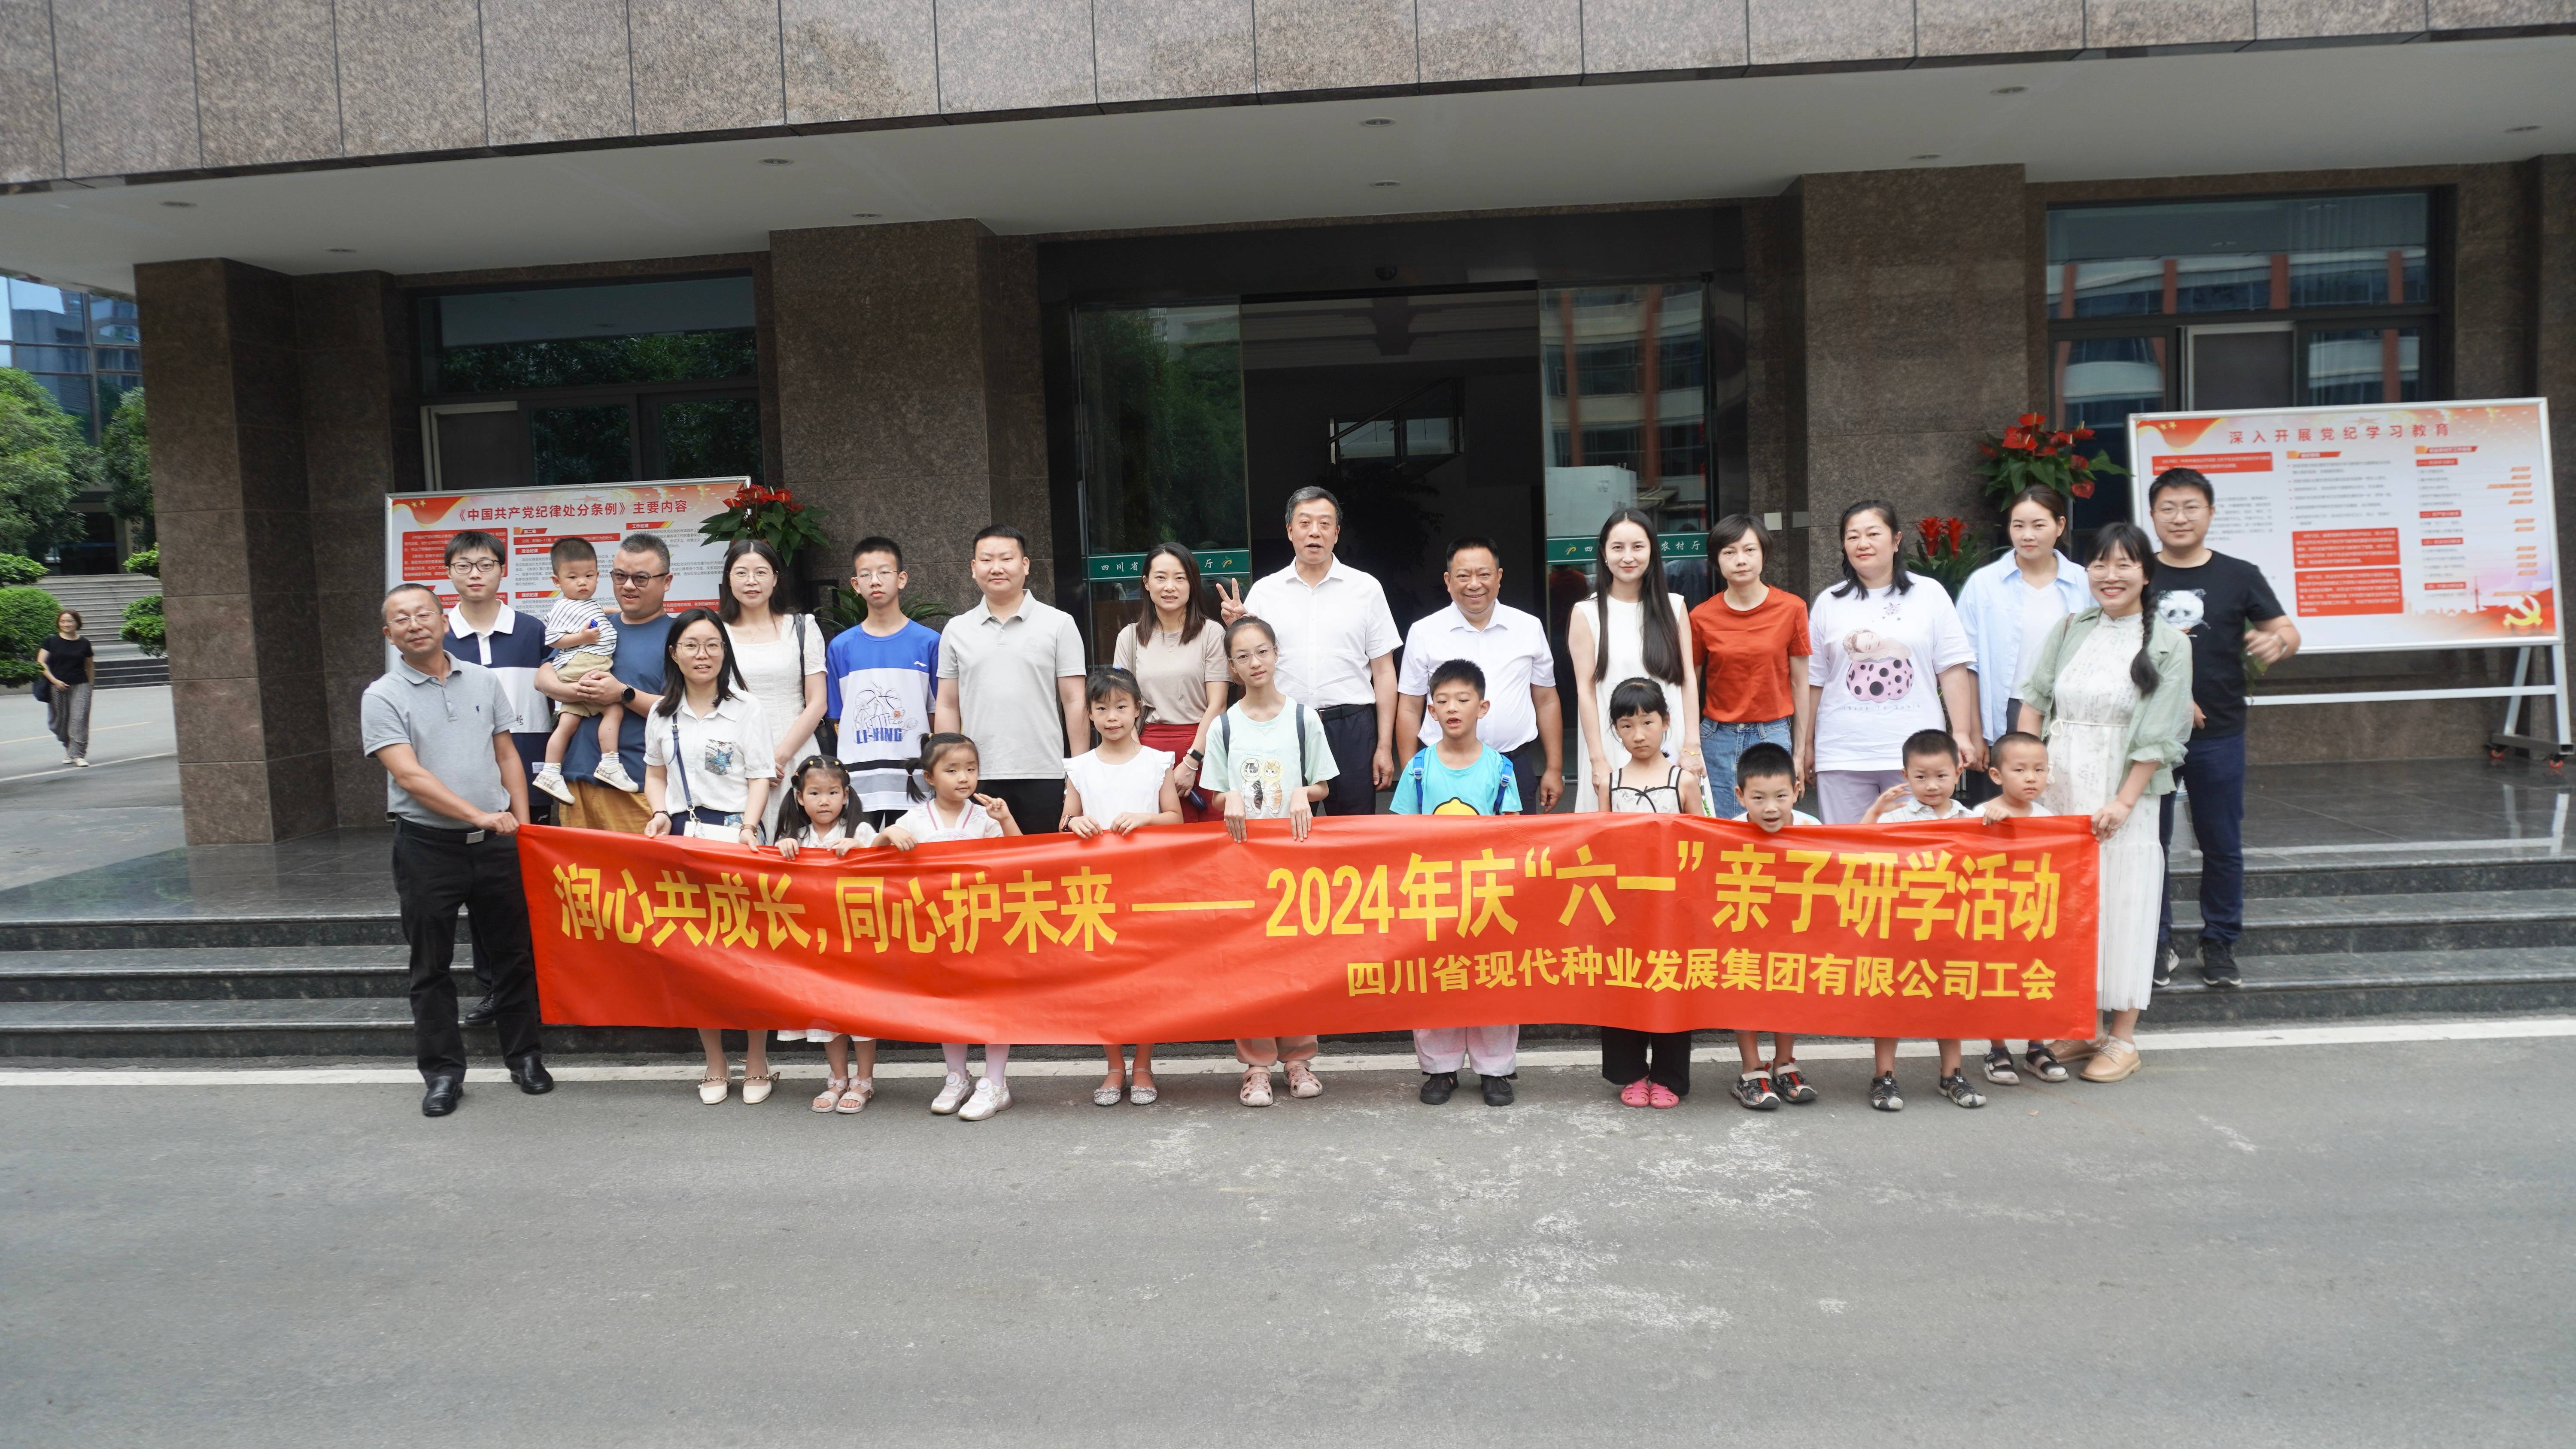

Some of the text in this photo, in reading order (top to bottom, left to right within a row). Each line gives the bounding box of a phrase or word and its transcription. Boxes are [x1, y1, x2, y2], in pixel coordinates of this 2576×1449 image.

[2229, 423, 2449, 444] 深入开展党纪学习教育
[1661, 540, 1701, 552] 农村厅
[1101, 559, 1213, 573] 四川省 厅
[1346, 947, 2057, 1001] 四川省现代种业发展集团有限公司工会
